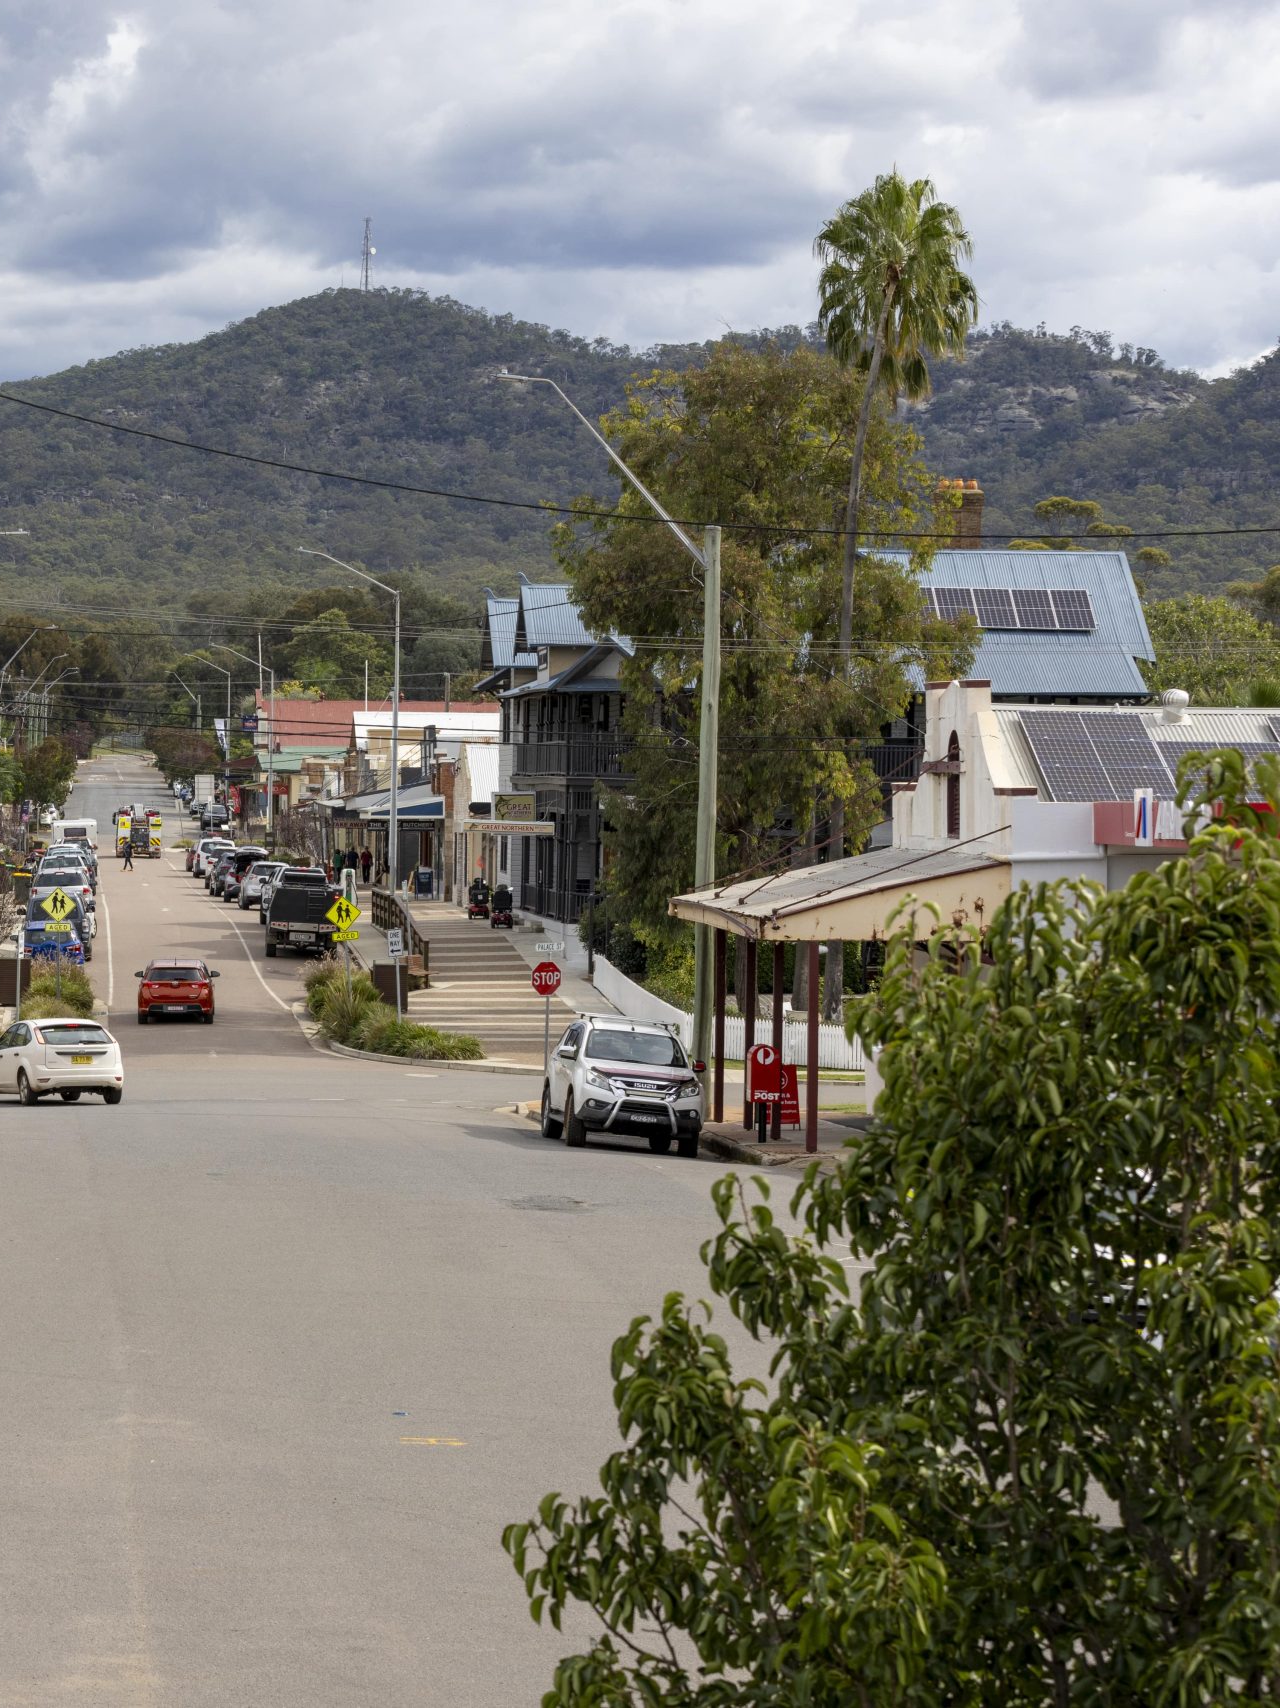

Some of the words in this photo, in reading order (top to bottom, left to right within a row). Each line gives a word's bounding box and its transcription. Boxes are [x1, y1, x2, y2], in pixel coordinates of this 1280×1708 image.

[506, 803, 532, 811] GREAT
[501, 824, 535, 832] NORTHERN
[336, 932, 356, 940] AGED
[533, 971, 561, 986] STOP
[633, 1082, 658, 1090] ISUZU
[754, 1092, 781, 1101] POST
